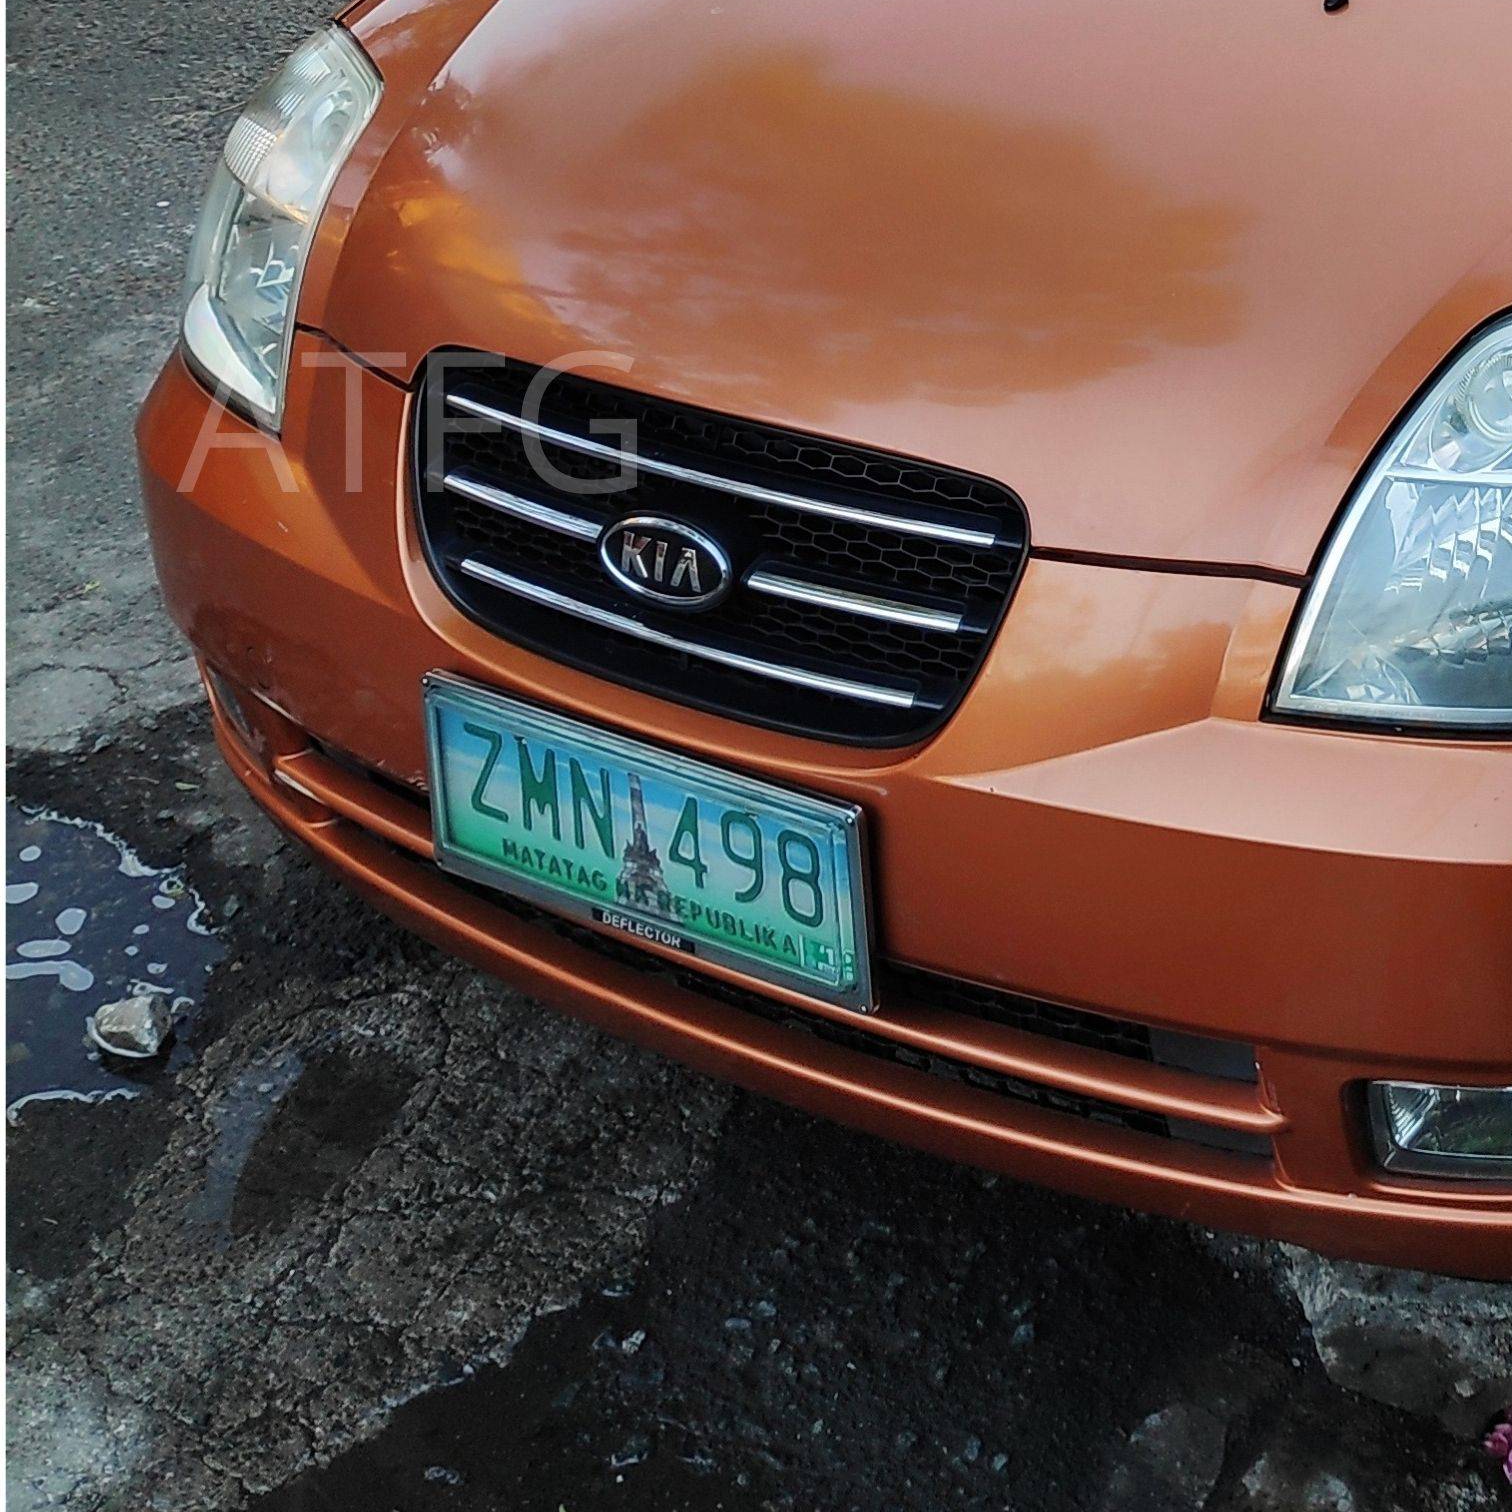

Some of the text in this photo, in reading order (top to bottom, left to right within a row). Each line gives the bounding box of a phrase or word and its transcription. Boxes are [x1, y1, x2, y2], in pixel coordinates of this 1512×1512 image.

[621, 530, 702, 593] KIA
[463, 721, 824, 928] ZMN 498
[502, 837, 609, 892] MATATAG
[655, 890, 798, 957] REPUBLIKA
[602, 910, 681, 949] DEFLECTOR
